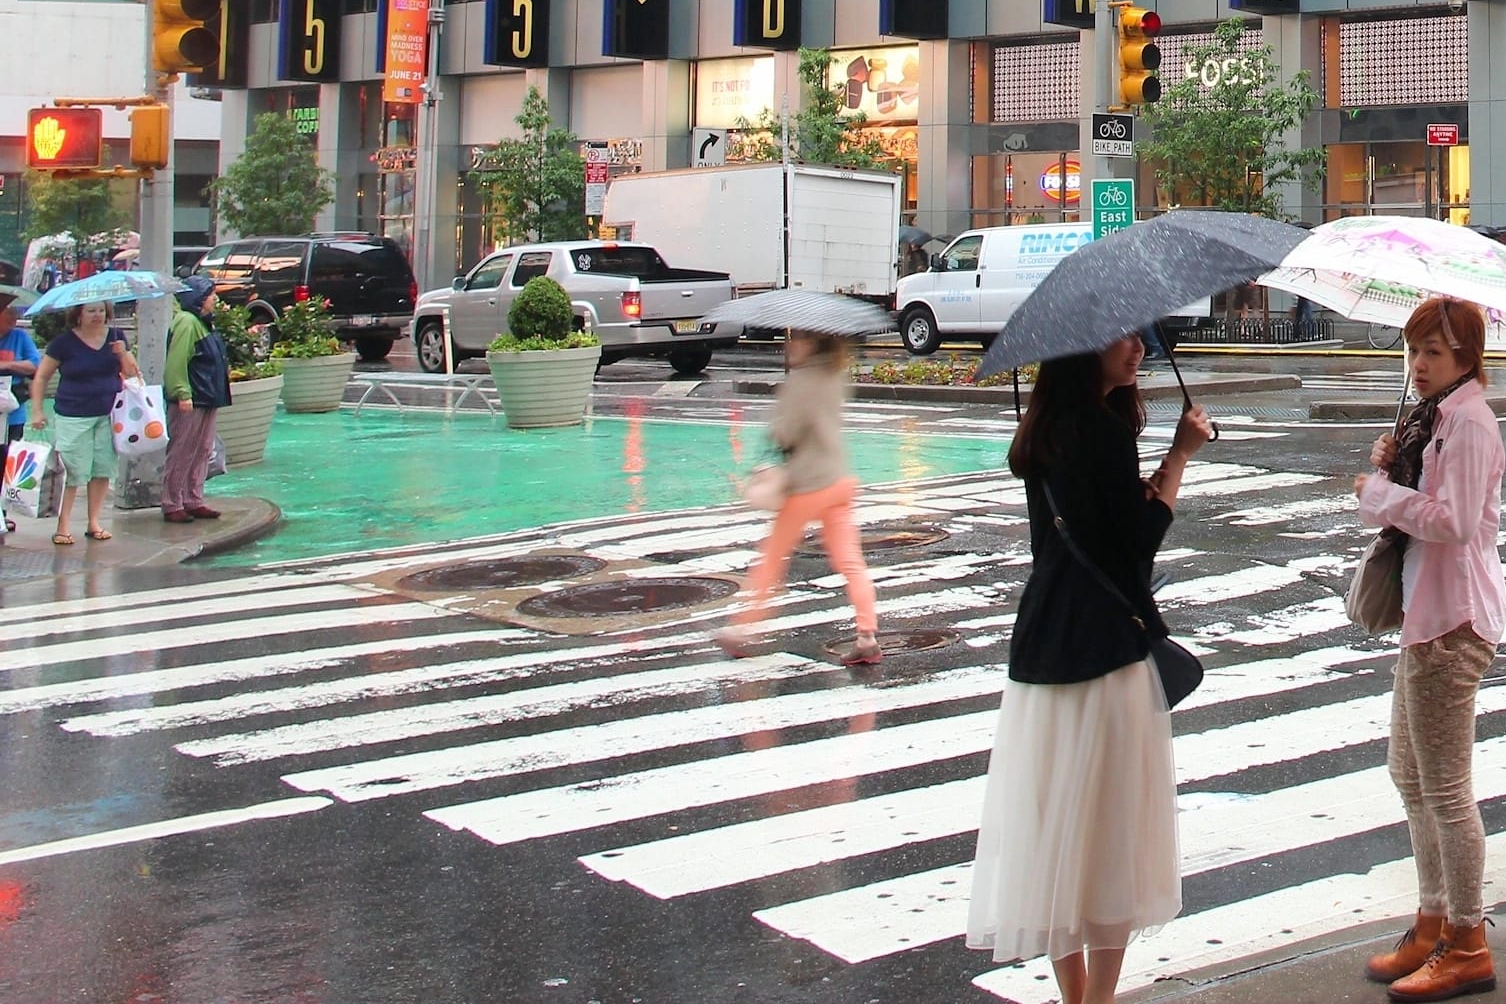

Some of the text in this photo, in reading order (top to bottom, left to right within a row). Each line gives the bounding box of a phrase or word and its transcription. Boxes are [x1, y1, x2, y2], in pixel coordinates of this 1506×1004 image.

[390, 51, 422, 63] YOGA
[389, 70, 422, 80] JUNE 21
[1094, 141, 1131, 154] BIKE PATH
[1100, 211, 1127, 223] East
[1100, 225, 1127, 237] Sid
[1018, 231, 1093, 254] RIMCO
[6, 487, 21, 501] NBC
